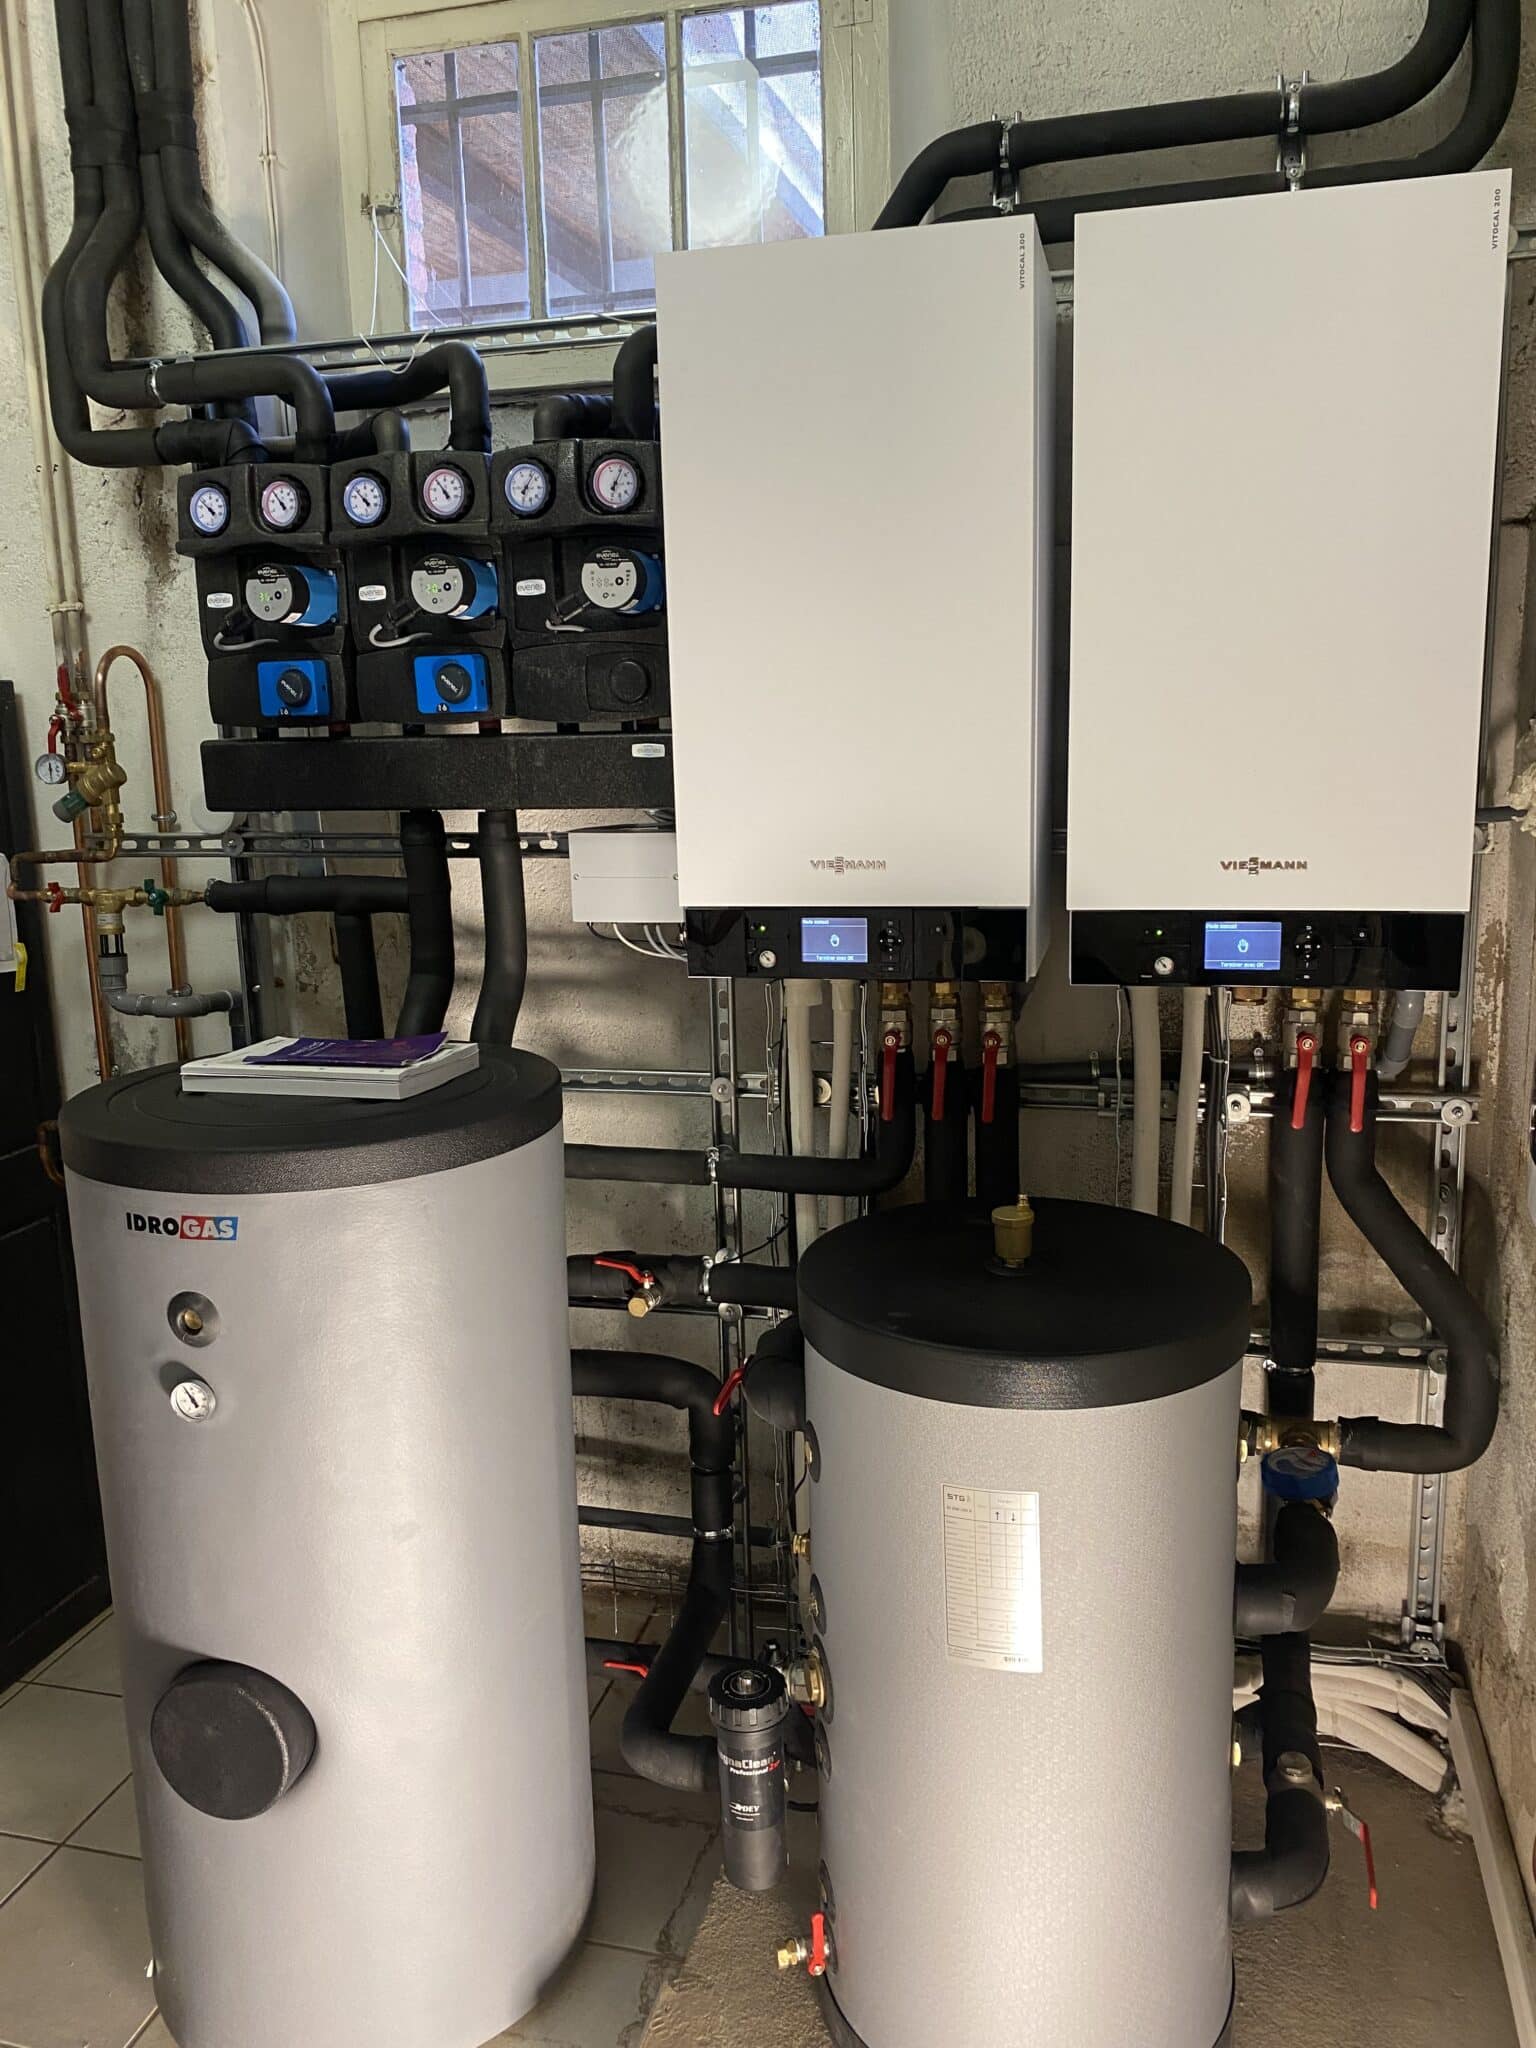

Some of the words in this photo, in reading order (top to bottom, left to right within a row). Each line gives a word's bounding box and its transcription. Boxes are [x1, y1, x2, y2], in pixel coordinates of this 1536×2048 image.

[1491, 209, 1500, 250] VITOCAL
[810, 856, 887, 873] VIESSMANN
[1220, 857, 1308, 875] VIESSMANN
